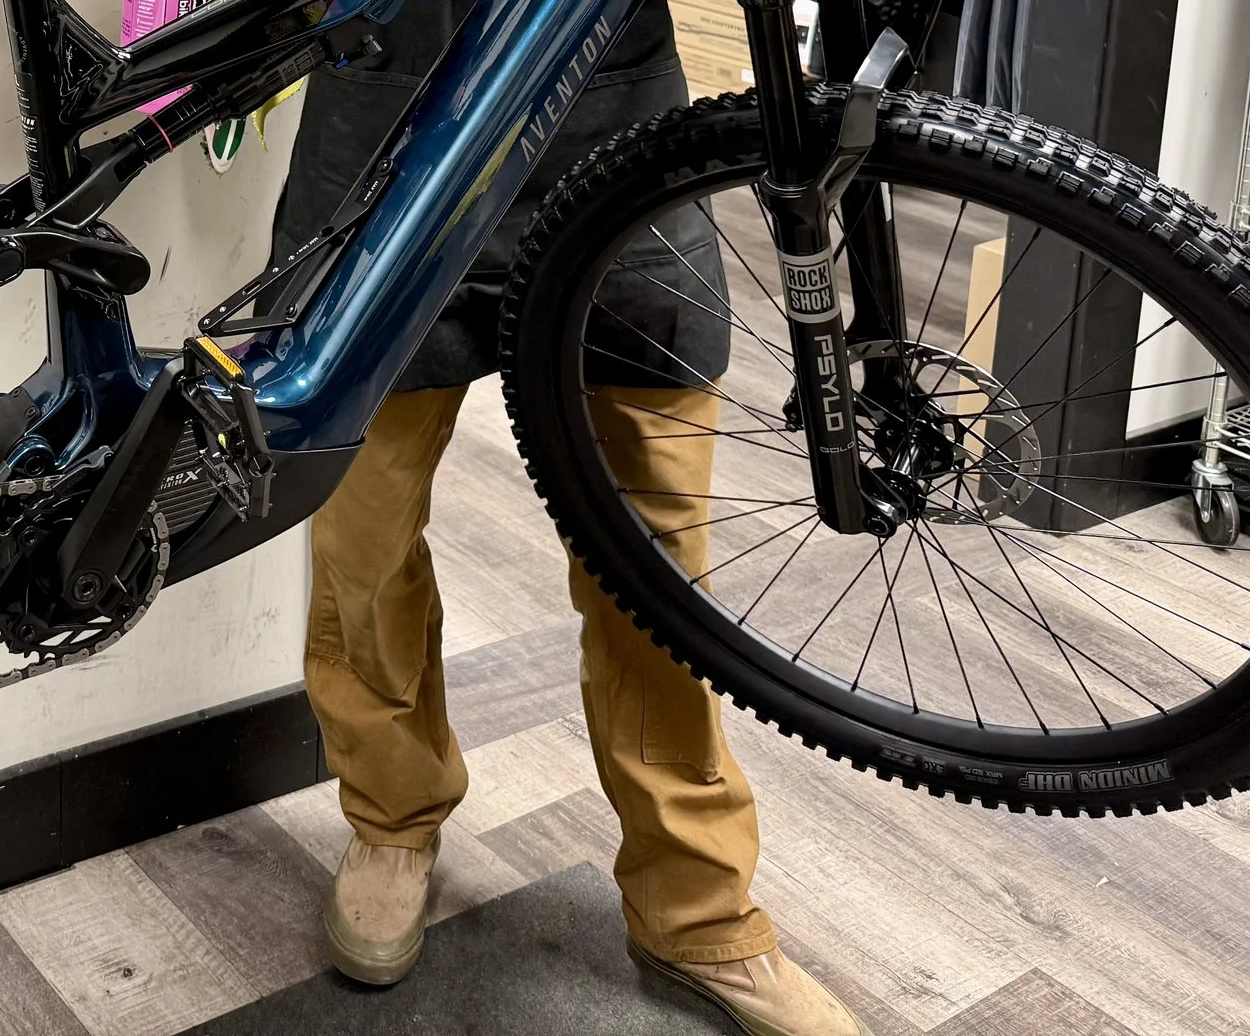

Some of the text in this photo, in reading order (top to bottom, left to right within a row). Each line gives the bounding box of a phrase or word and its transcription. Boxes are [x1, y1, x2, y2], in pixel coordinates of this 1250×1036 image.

[520, 15, 612, 162] AVENTON
[786, 265, 828, 288] ROCK
[790, 290, 832, 312] SHOX
[814, 334, 844, 432] PSYLO
[820, 442, 855, 453] GOLD
[1018, 758, 1176, 793] MINION DHF
